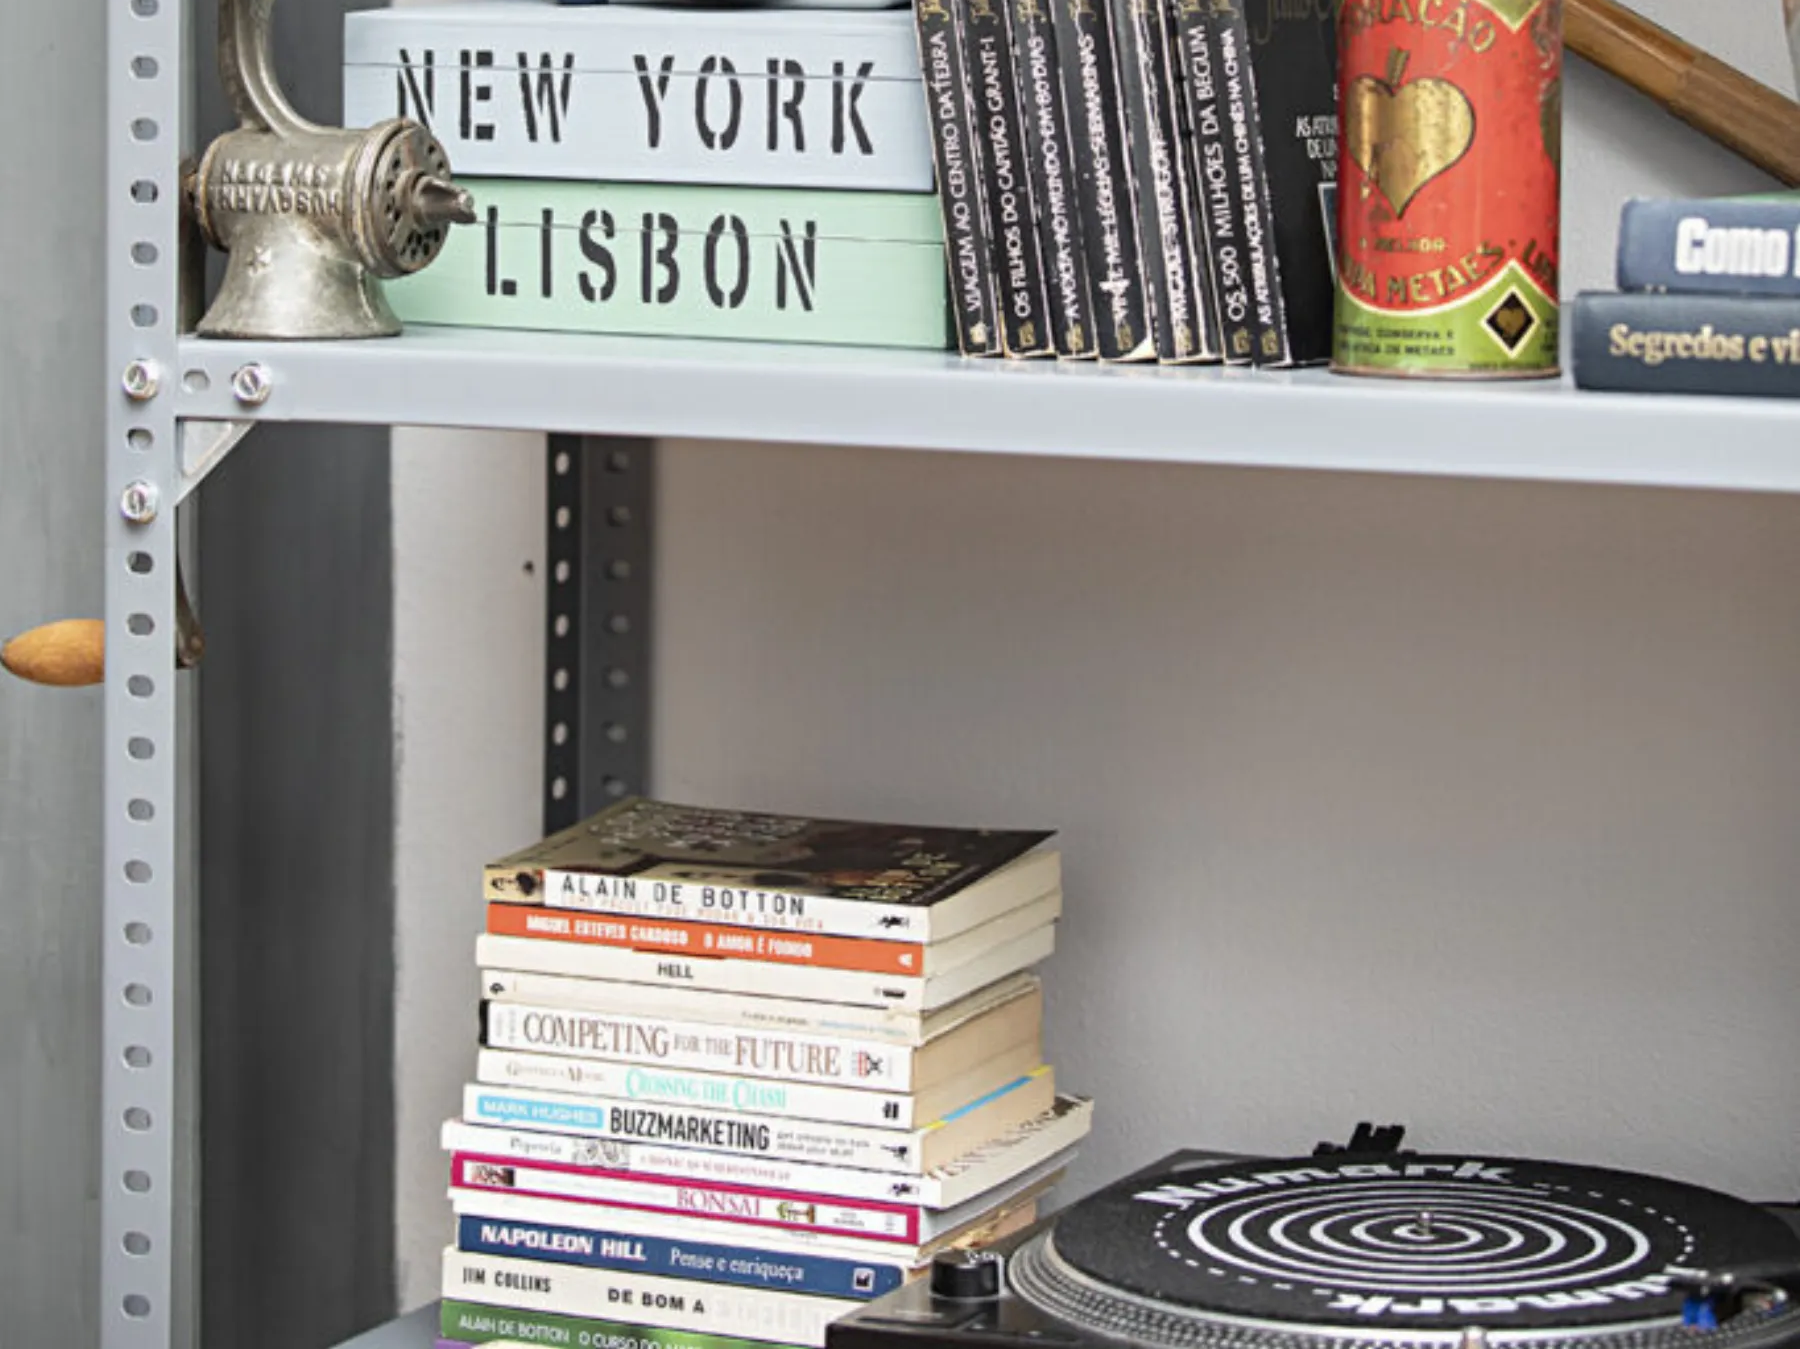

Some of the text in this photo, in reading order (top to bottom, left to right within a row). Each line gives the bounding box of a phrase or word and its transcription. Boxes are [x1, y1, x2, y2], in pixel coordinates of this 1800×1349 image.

[1218, 26, 1240, 76] CHINA
[398, 47, 875, 155] NEW YORK
[1075, 32, 1109, 152] SUBMARINAS
[1225, 76, 1243, 98] NA
[927, 30, 983, 310] VIAGEM AO CENTRO DA TERRA
[986, 114, 1014, 189] CAPITÃO
[1187, 23, 1246, 322] OS 500 MILHÕES DA BEGUM
[1235, 153, 1254, 181] UM
[1026, 34, 1081, 319] A VOLTA AO MUNDO EM 80 DIAS
[1239, 181, 1257, 200] DE
[999, 191, 1019, 222] DO
[486, 205, 817, 312] LISBON
[1004, 225, 1028, 287] FILHOS
[1675, 216, 1789, 278] Como
[1013, 290, 1032, 317] OS
[1256, 303, 1274, 325] AS
[1609, 322, 1745, 366] Segredos
[1748, 336, 1768, 363] e
[562, 873, 805, 916] ALAIN DE BOTTON
[657, 962, 694, 980] HELL
[522, 1011, 669, 1059] COMPETING
[672, 1033, 700, 1052] FOR
[706, 1036, 731, 1056] THE
[735, 1034, 842, 1077] FUTURE
[625, 1067, 698, 1099] CROSSING
[702, 1080, 727, 1101] THE
[732, 1080, 787, 1111] CHASM
[610, 1106, 770, 1151] BUZZMARKETING
[676, 1184, 760, 1217] BONSAI
[1132, 1161, 1516, 1209] Numark
[481, 1224, 804, 1284] NAPOLEON HILL Pense e enriqueça
[462, 1267, 705, 1314] JIM COLLINS DE BOM A
[458, 1314, 496, 1333] ALAIN
[499, 1319, 516, 1336] DE
[518, 1322, 570, 1343] BOTTON
[578, 1330, 590, 1344] O
